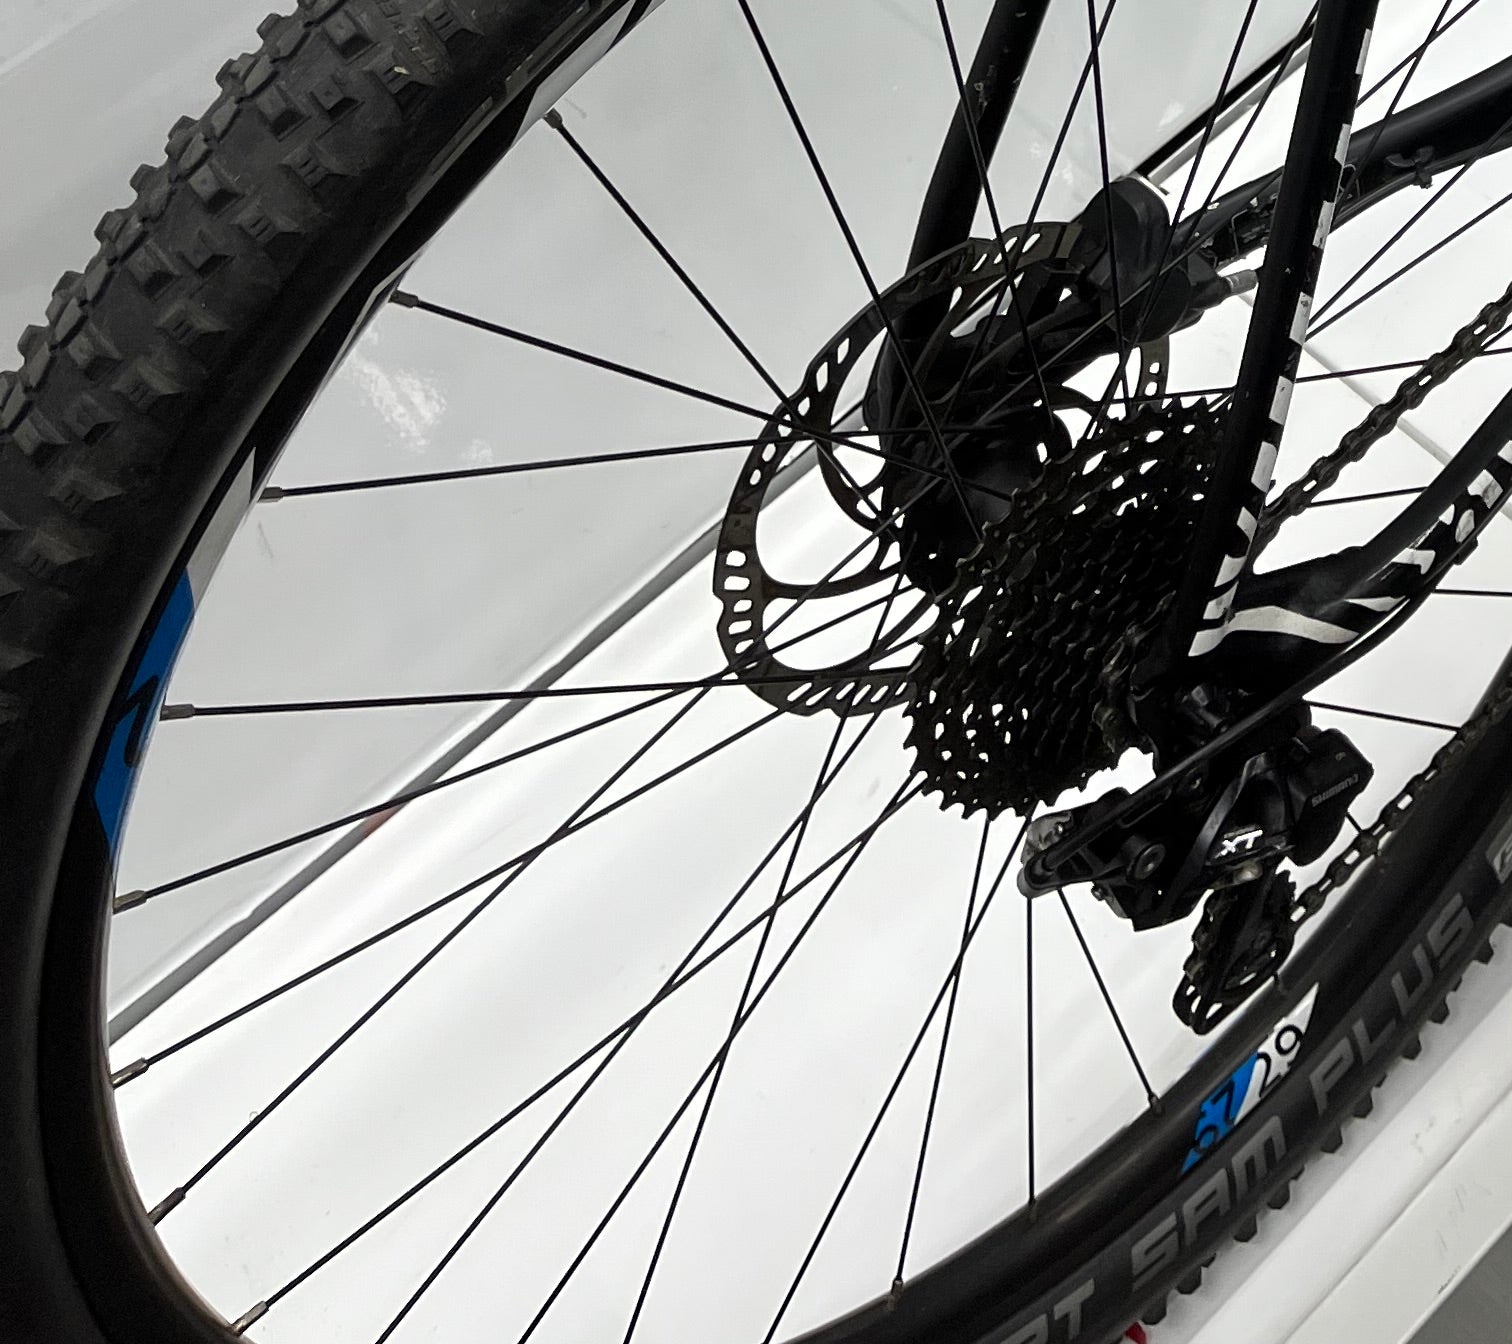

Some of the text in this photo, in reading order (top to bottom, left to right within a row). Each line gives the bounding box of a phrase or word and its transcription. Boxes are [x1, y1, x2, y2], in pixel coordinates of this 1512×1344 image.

[1310, 773, 1359, 808] SHIMANO
[1131, 1114, 1288, 1293] SAM
[1308, 891, 1475, 1116] PLUS
